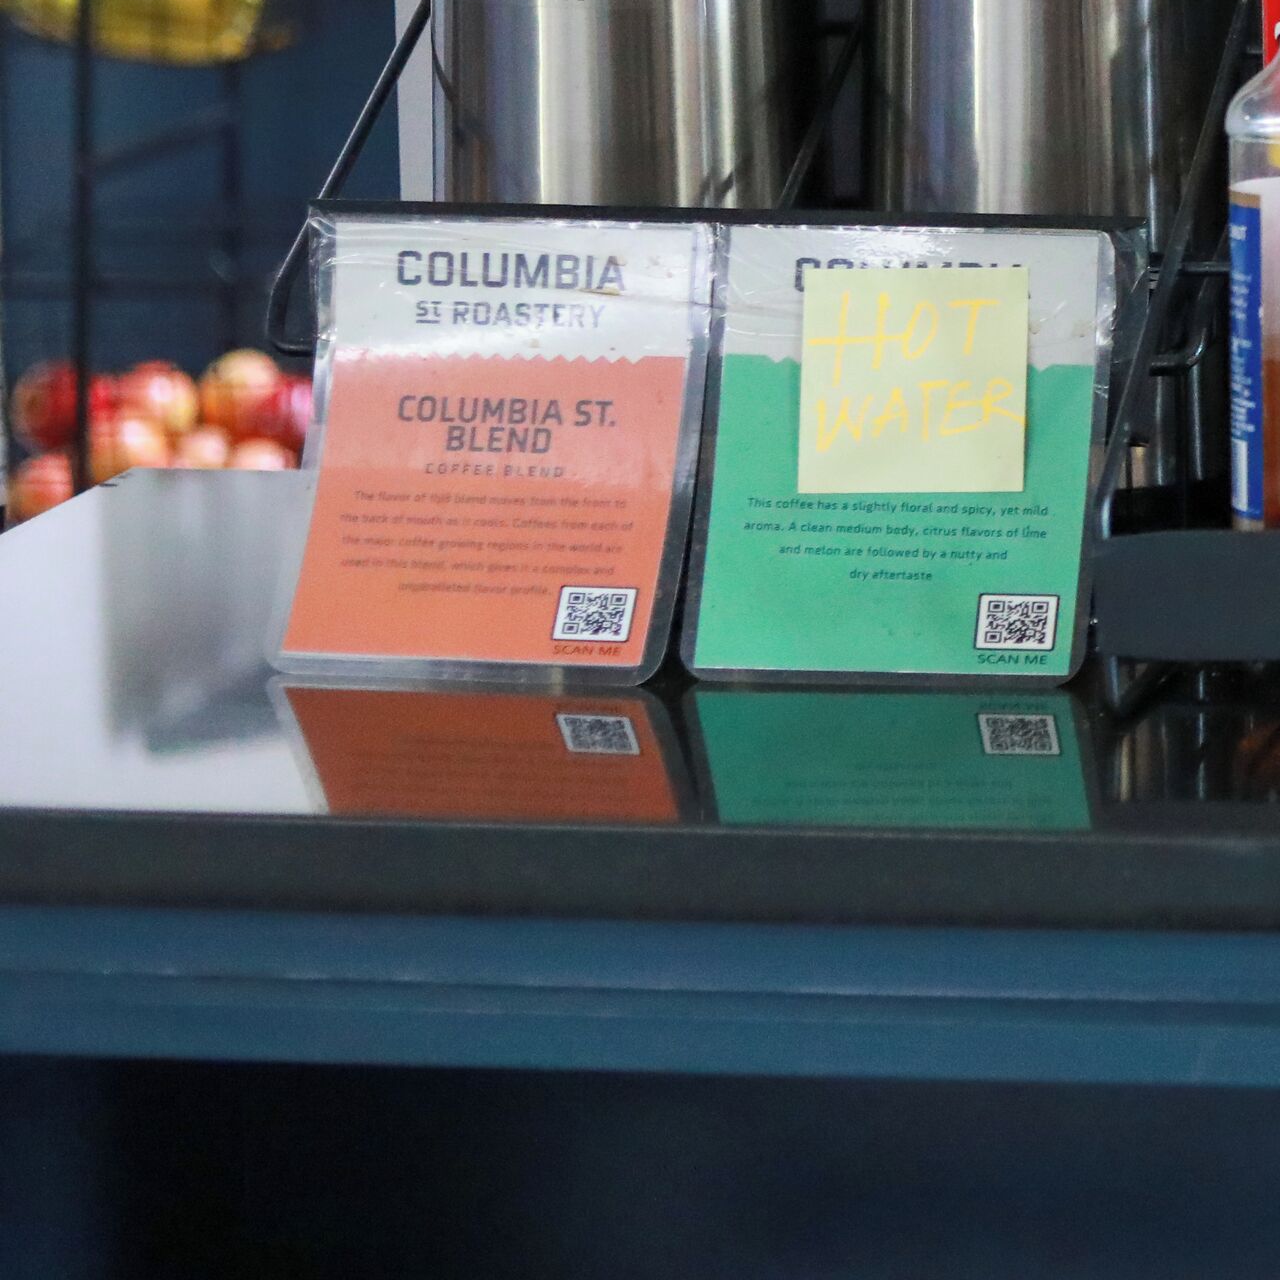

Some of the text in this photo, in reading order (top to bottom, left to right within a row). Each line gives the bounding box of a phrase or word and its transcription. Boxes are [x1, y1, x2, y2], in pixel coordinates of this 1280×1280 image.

[397, 250, 626, 291] COLUMBIA
[452, 301, 606, 328] ROASTERY
[808, 291, 999, 387] HOT
[398, 395, 616, 427] COLUMBIA ST.
[815, 377, 1027, 454] WATER
[446, 425, 553, 454] BLEND
[425, 463, 565, 478] COFFEE BLEND
[747, 498, 1048, 517] This coffee has a slightly floral and spicy, yet mild
[743, 522, 1047, 538] aroma. A clean medium body, citrus flavors of lime
[779, 545, 801, 554] and
[804, 546, 841, 556] melon
[845, 548, 863, 556] are
[867, 547, 919, 558] followed
[922, 548, 937, 560] by
[950, 550, 982, 561] nutty
[985, 550, 1008, 560] and
[850, 569, 933, 581] dry aftertaste
[552, 645, 623, 658] SCAN ME
[977, 653, 1048, 665] SCAN ME
